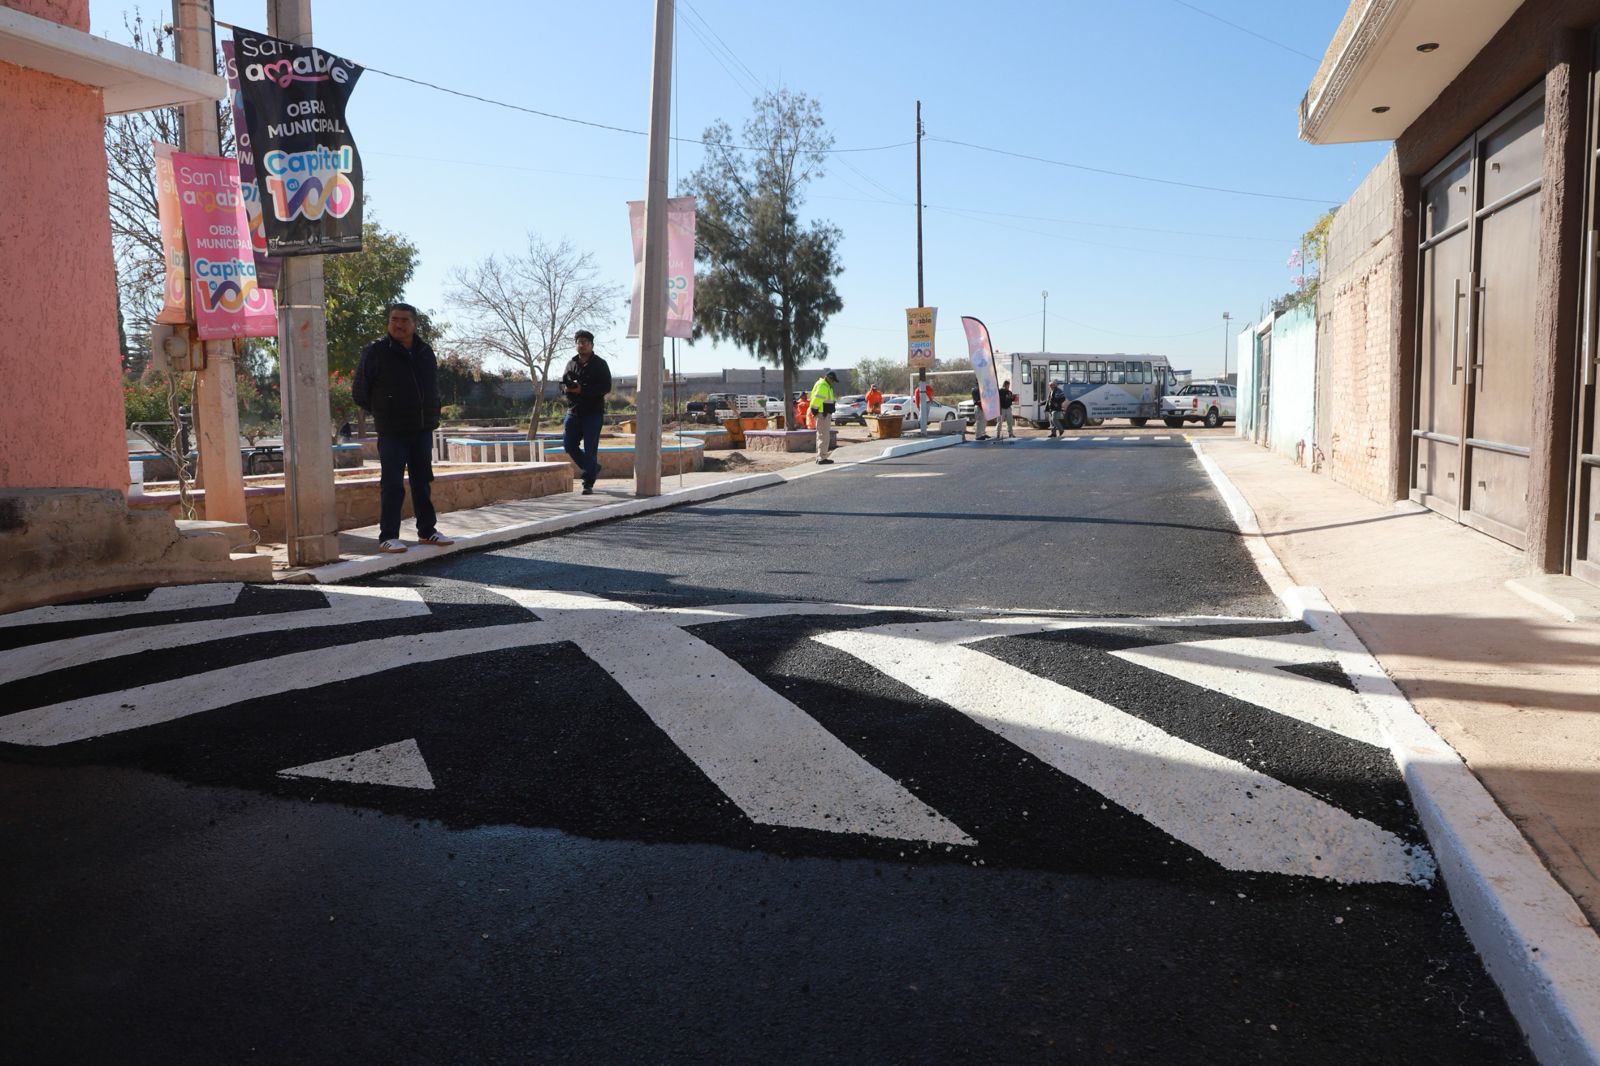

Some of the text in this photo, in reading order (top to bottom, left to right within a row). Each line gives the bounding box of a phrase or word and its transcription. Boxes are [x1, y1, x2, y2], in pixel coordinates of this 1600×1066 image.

[287, 100, 326, 117] OBRA
[267, 118, 345, 139] MUNICIPAL
[266, 147, 350, 177] Capital
[180, 167, 217, 186] San
[209, 225, 241, 236] OBRA
[196, 258, 256, 280] Capita
